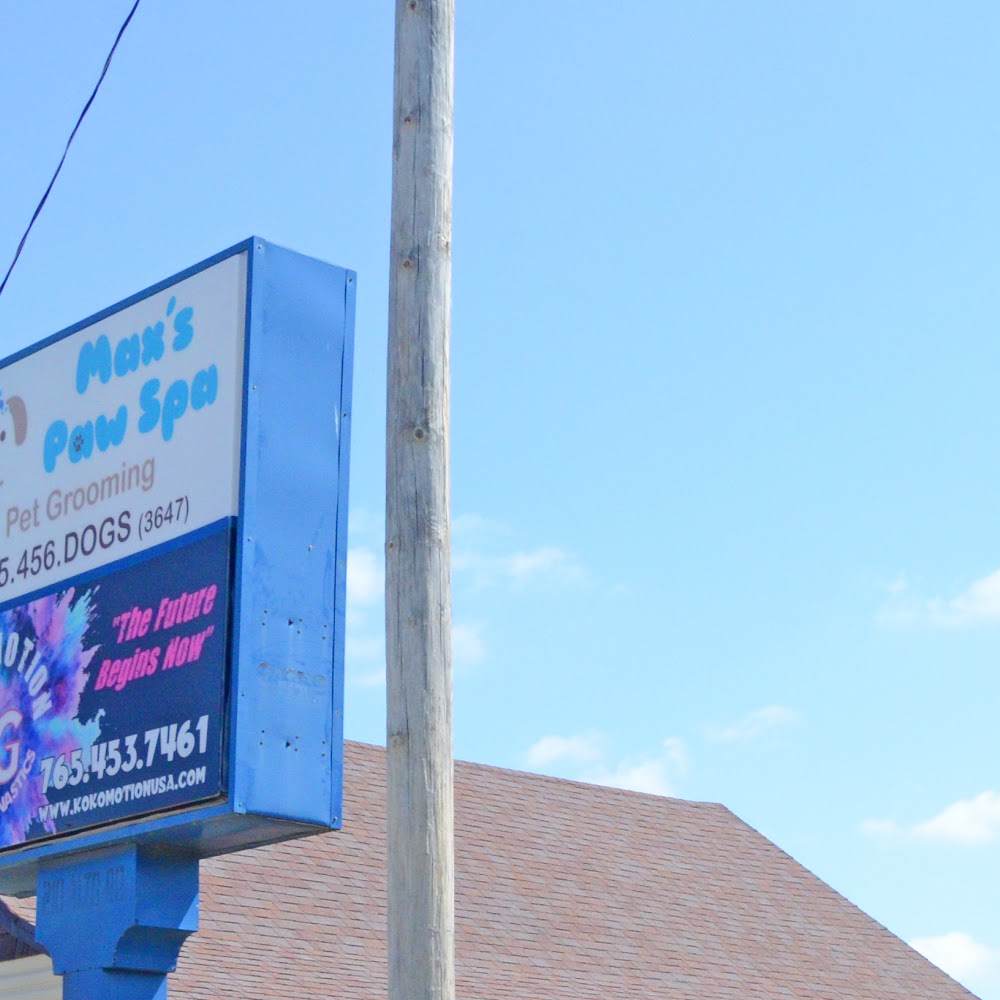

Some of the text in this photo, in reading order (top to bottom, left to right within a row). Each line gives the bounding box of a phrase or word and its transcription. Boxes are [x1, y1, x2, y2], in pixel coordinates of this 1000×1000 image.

[76, 295, 194, 395] Max's
[43, 364, 218, 473] Paw Spa
[5, 457, 155, 538] Pet Grooming
[138, 495, 190, 541] (3647)
[153, 584, 217, 632] Future
[94, 646, 161, 691] Begins
[39, 714, 209, 794] 765.453.7461
[38, 765, 207, 822] WWW.KOKOMOTIONUSA.COM
